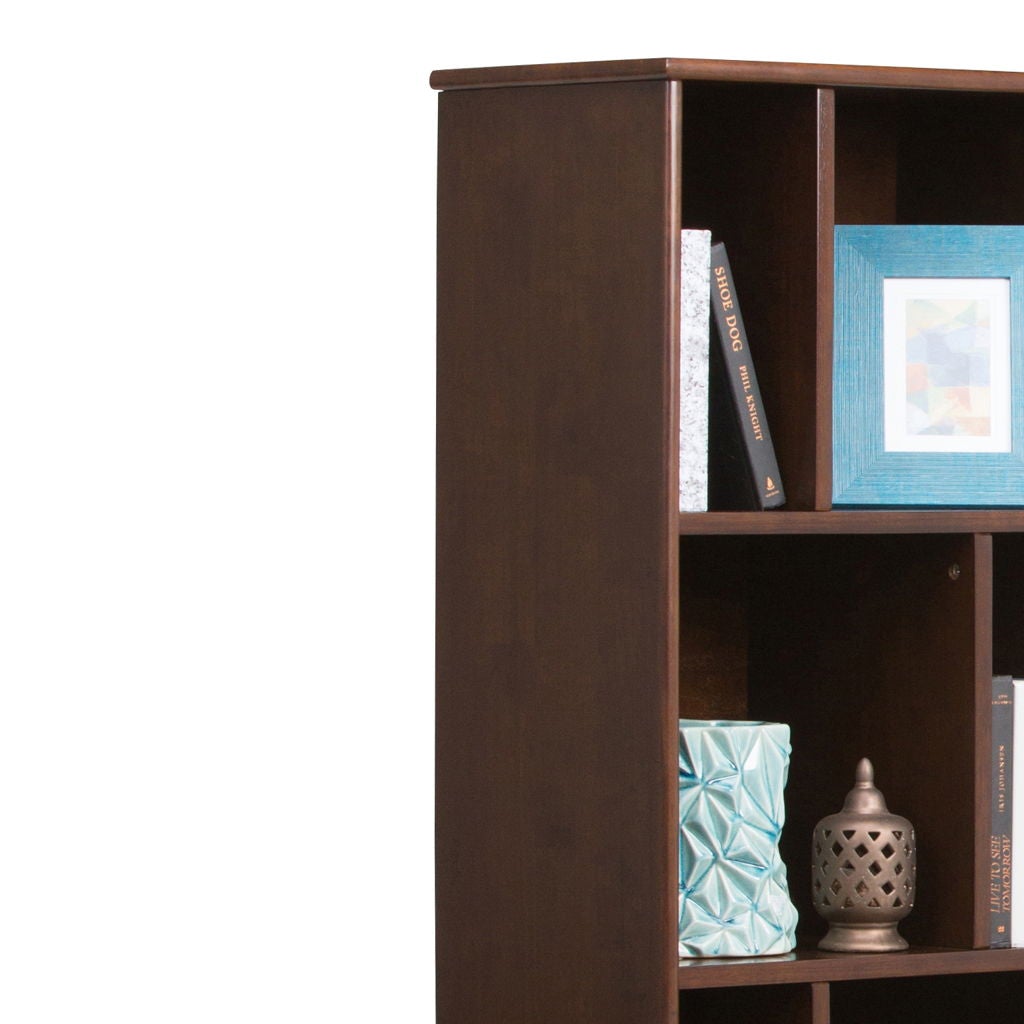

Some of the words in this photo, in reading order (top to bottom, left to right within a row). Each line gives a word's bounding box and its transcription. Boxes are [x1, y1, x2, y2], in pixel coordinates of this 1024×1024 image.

[714, 266, 734, 311] SHOE
[726, 314, 743, 352] DOG
[739, 365, 752, 392] PHIL
[745, 395, 764, 441] KNIGHT
[991, 835, 1001, 859] SEE
[990, 862, 1001, 880] TO
[1002, 834, 1011, 912] TOMORROW
[990, 882, 1001, 913] LIVE
